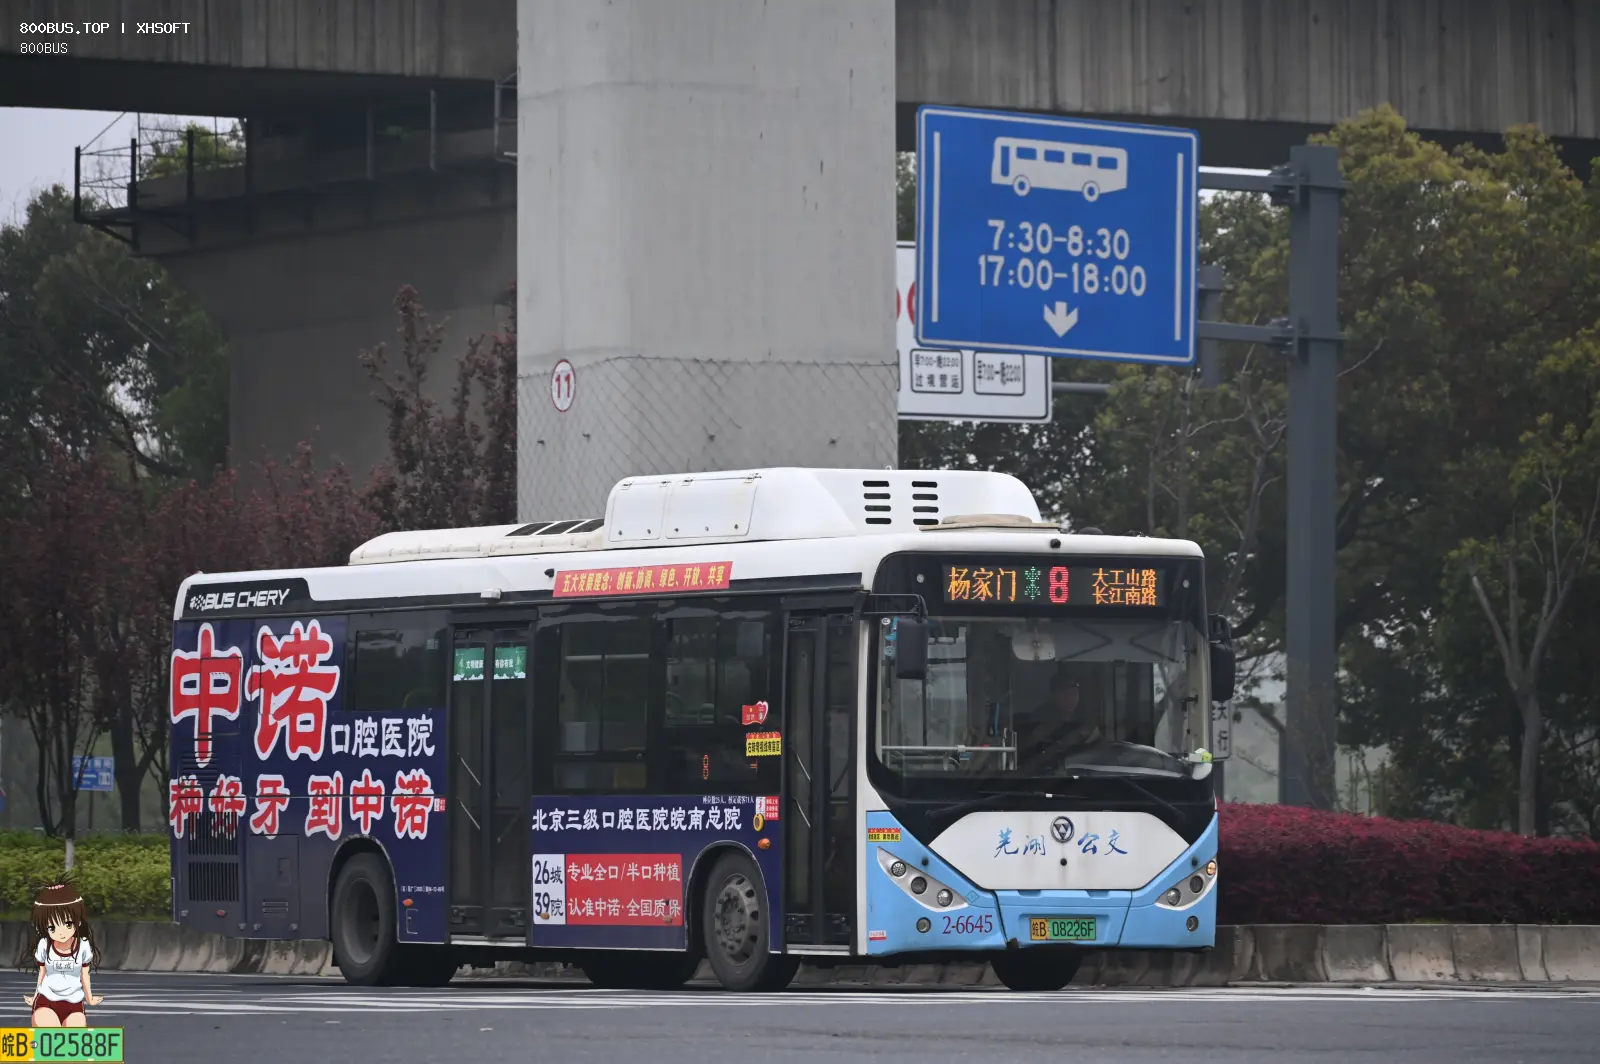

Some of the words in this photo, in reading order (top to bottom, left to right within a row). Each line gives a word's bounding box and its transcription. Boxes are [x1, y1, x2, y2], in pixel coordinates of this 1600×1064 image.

[987, 219, 1130, 260] 7:30-8:30
[978, 254, 1147, 297] 17:00-18:00
[555, 372, 571, 399] 11
[947, 566, 1017, 602] 杨家门
[1049, 566, 1069, 603] 8
[1092, 567, 1157, 588] 大工山路
[204, 592, 236, 610] BUS
[237, 588, 290, 608] CHERY
[1092, 585, 1157, 606] 长江南路
[169, 619, 340, 768] 中诺
[330, 714, 435, 758] 口腔医院
[304, 768, 435, 840] 到中诺
[532, 806, 742, 832] 北京三级口腔医院皖南总院
[993, 828, 1046, 859] 芜湖
[1077, 829, 1128, 856] 公交
[533, 860, 564, 885] 26城
[567, 861, 681, 883] 专业全口/半口种植
[533, 892, 564, 918] 39院
[567, 897, 682, 918] 认准中诺·全国质保
[942, 914, 993, 935] 2-6645
